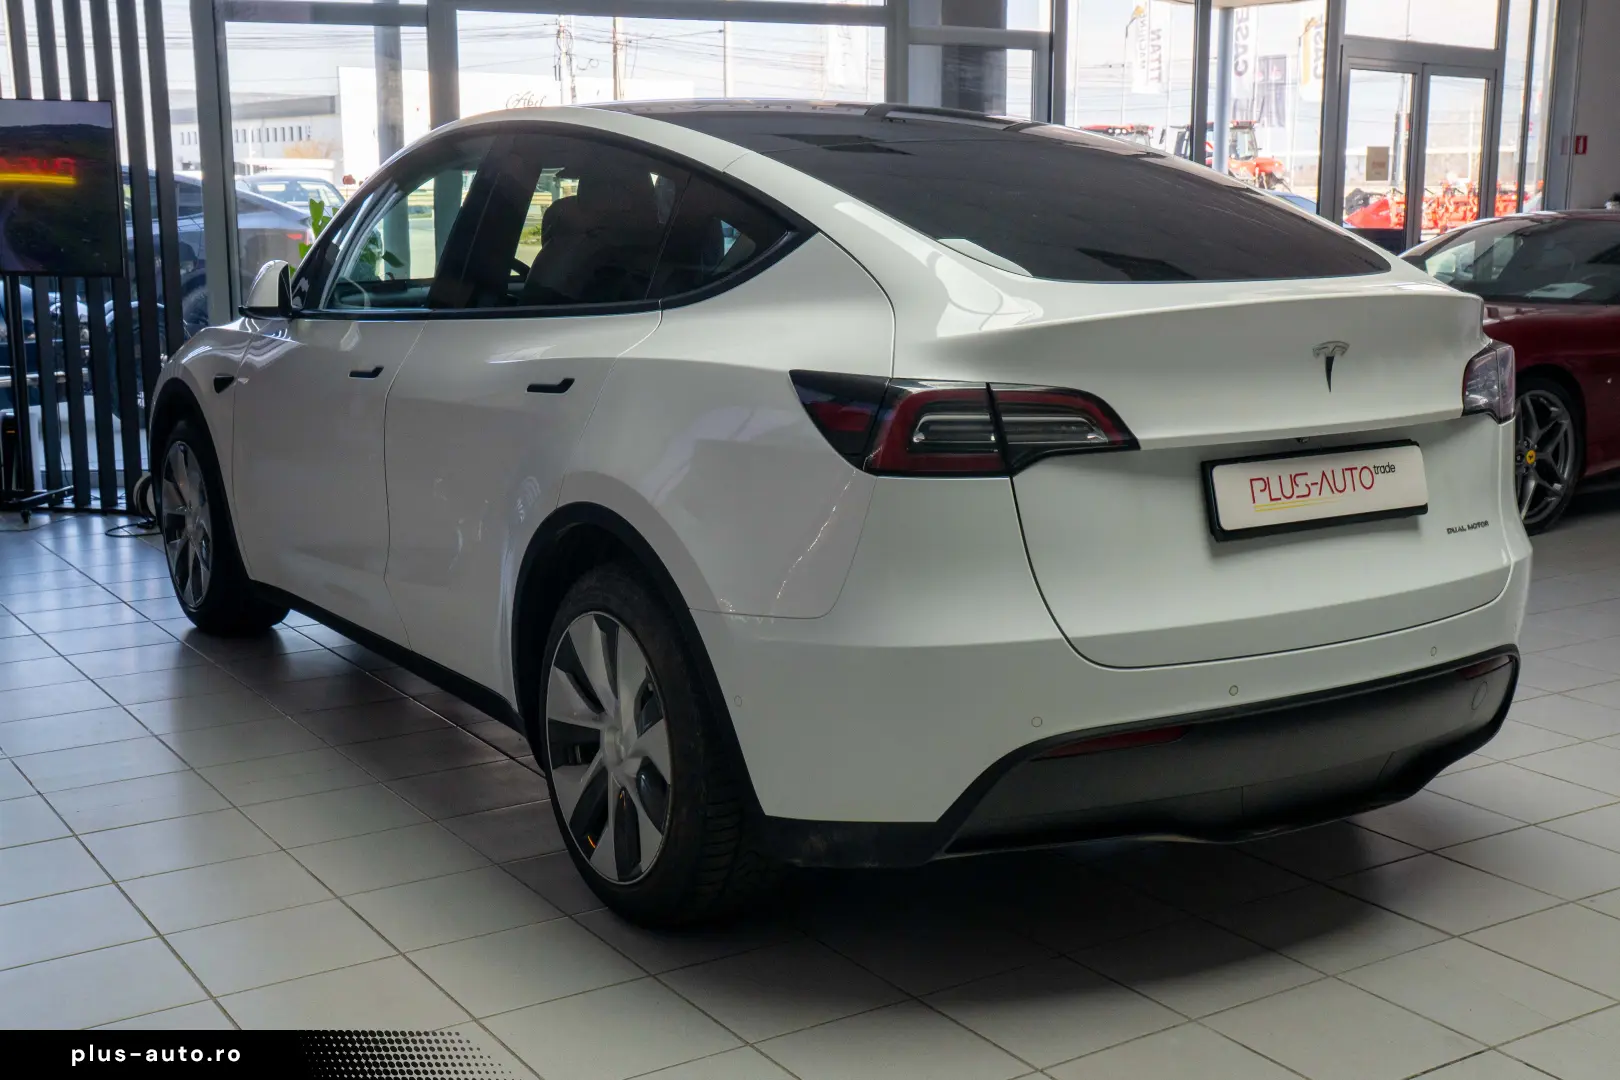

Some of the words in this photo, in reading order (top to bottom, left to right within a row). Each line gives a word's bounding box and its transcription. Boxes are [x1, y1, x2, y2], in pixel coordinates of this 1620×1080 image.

[1250, 466, 1375, 504] PLUS-AUTO
[1373, 462, 1396, 475] trade
[1446, 525, 1467, 535] DUAL
[1467, 520, 1490, 530] MOTOR
